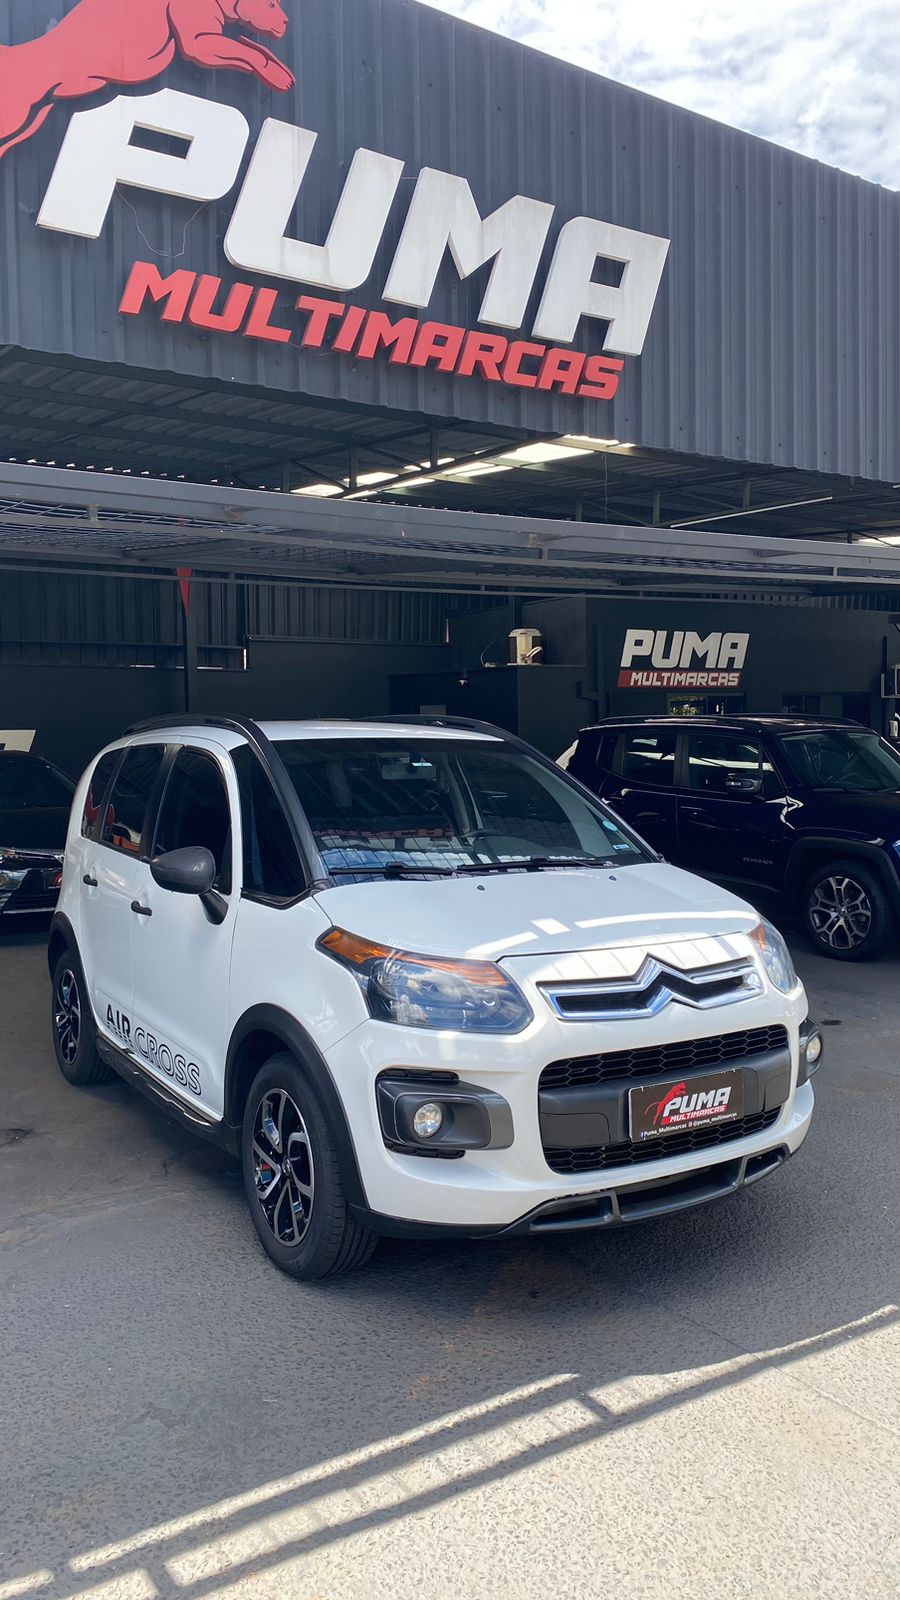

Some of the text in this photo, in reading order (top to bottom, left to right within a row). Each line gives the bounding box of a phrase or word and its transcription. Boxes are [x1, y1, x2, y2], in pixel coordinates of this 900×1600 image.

[36, 87, 671, 356] PUMA
[117, 261, 625, 400] MULTIMARCAS
[620, 629, 750, 669] PUMA
[630, 672, 740, 686] MULTIMARCAS
[106, 1003, 202, 1096] AIR CROSS
[662, 1086, 732, 1118] PUMA
[669, 1105, 727, 1123] MULTIMARCAS
